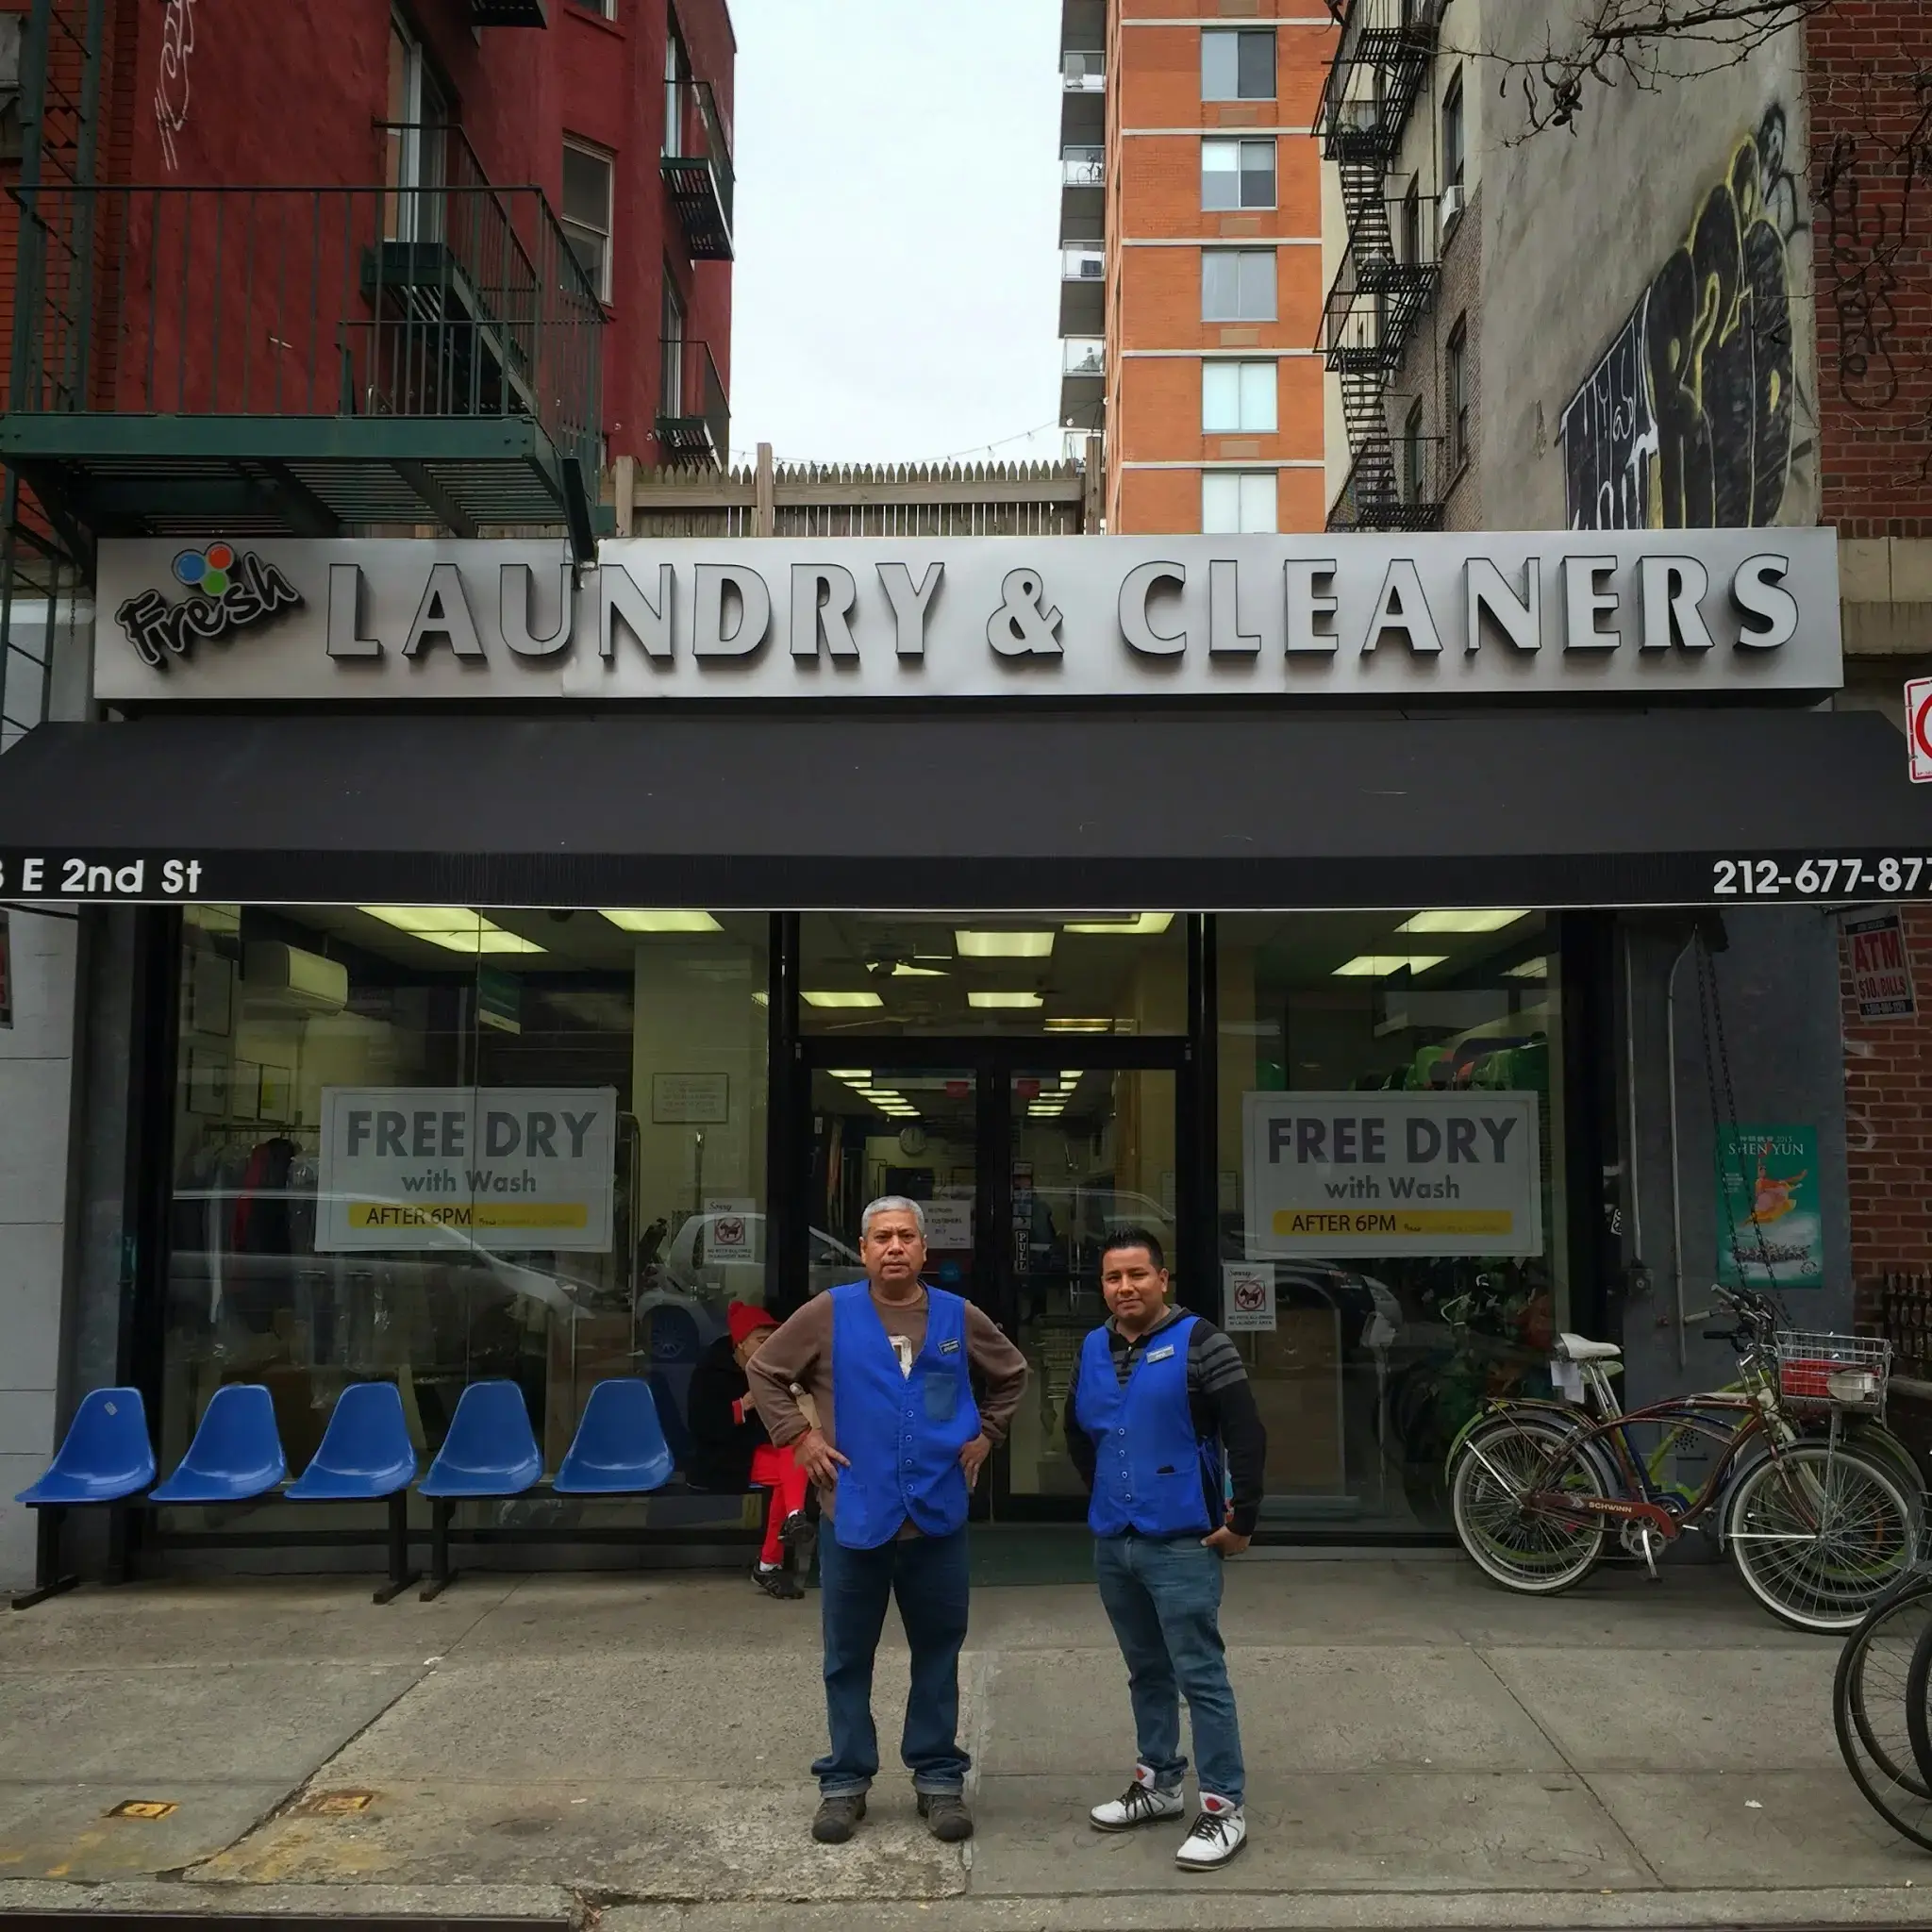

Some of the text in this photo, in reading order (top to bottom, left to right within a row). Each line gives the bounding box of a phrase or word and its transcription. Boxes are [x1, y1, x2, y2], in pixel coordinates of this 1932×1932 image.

[113, 550, 305, 668] Fresh
[326, 553, 1800, 661] LAUNDRY & CLEANERS
[22, 858, 44, 891] E
[60, 858, 144, 893] 2nd
[161, 859, 202, 893] St
[1713, 857, 1932, 895] 212-677-87
[1853, 930, 1903, 973] ATM
[1880, 975, 1907, 997] BILLS
[347, 1110, 597, 1158] FREE DRY
[1268, 1117, 1518, 1163] FREE DRY
[1728, 1142, 1804, 1156] SHEN YUN
[401, 1169, 536, 1192] with Wash
[1324, 1175, 1460, 1199] with Wash
[366, 1208, 425, 1224] AFTER
[430, 1208, 472, 1224] 6PM
[1291, 1215, 1350, 1231] AFTER
[1356, 1215, 1396, 1231] 6PM
[1018, 1231, 1027, 1272] PULL
[1589, 1501, 1633, 1513] SCHWINN
